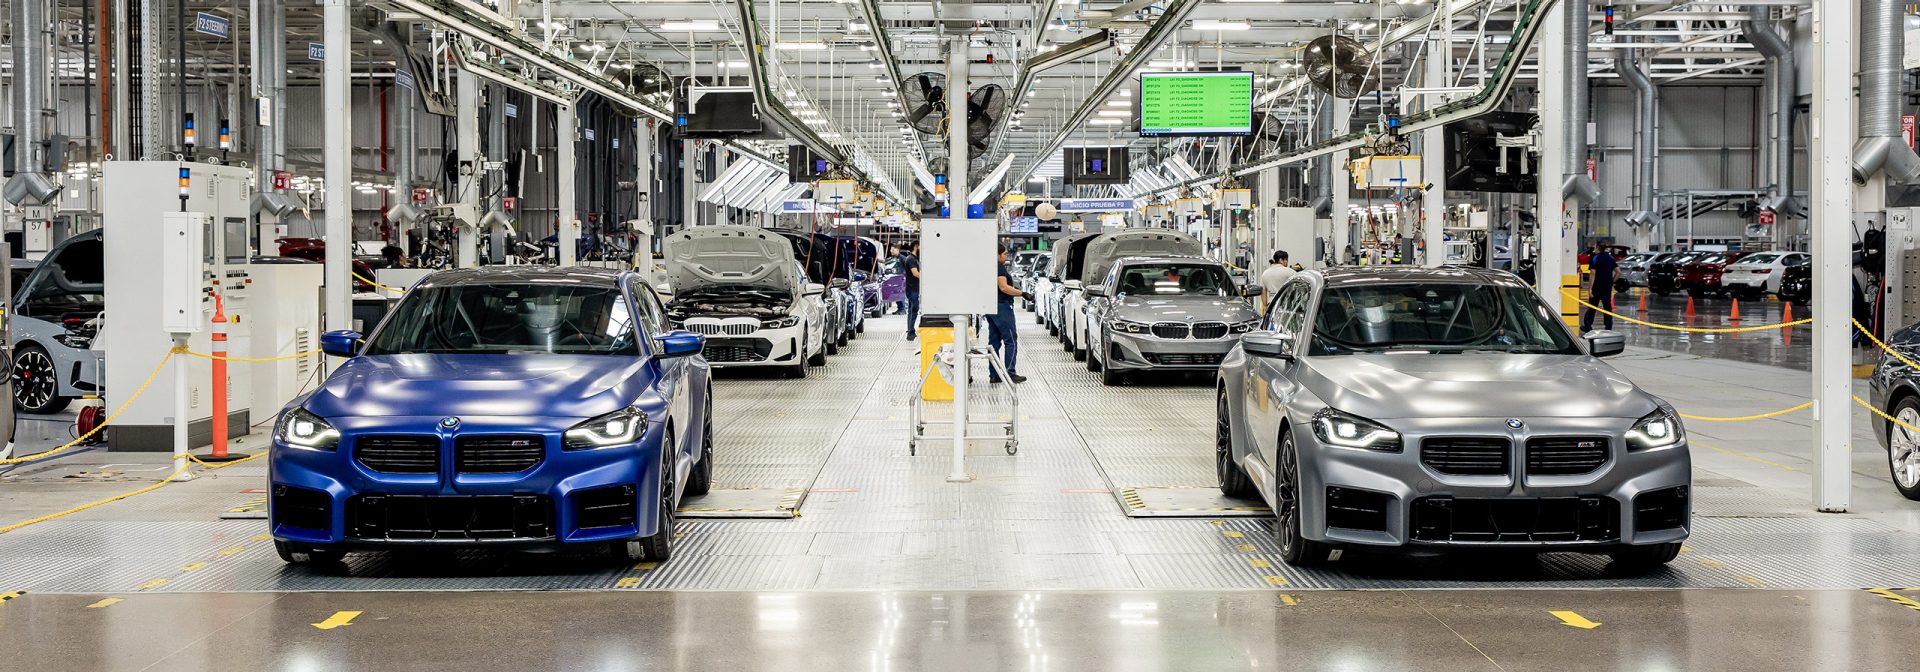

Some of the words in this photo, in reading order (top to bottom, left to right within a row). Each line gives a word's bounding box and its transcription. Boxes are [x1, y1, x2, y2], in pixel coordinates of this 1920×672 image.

[199, 17, 206, 29] F2
[311, 47, 318, 57] F2
[32, 209, 41, 219] M
[1565, 210, 1572, 218] K
[31, 221, 42, 231] 57
[1563, 221, 1574, 230] 57
